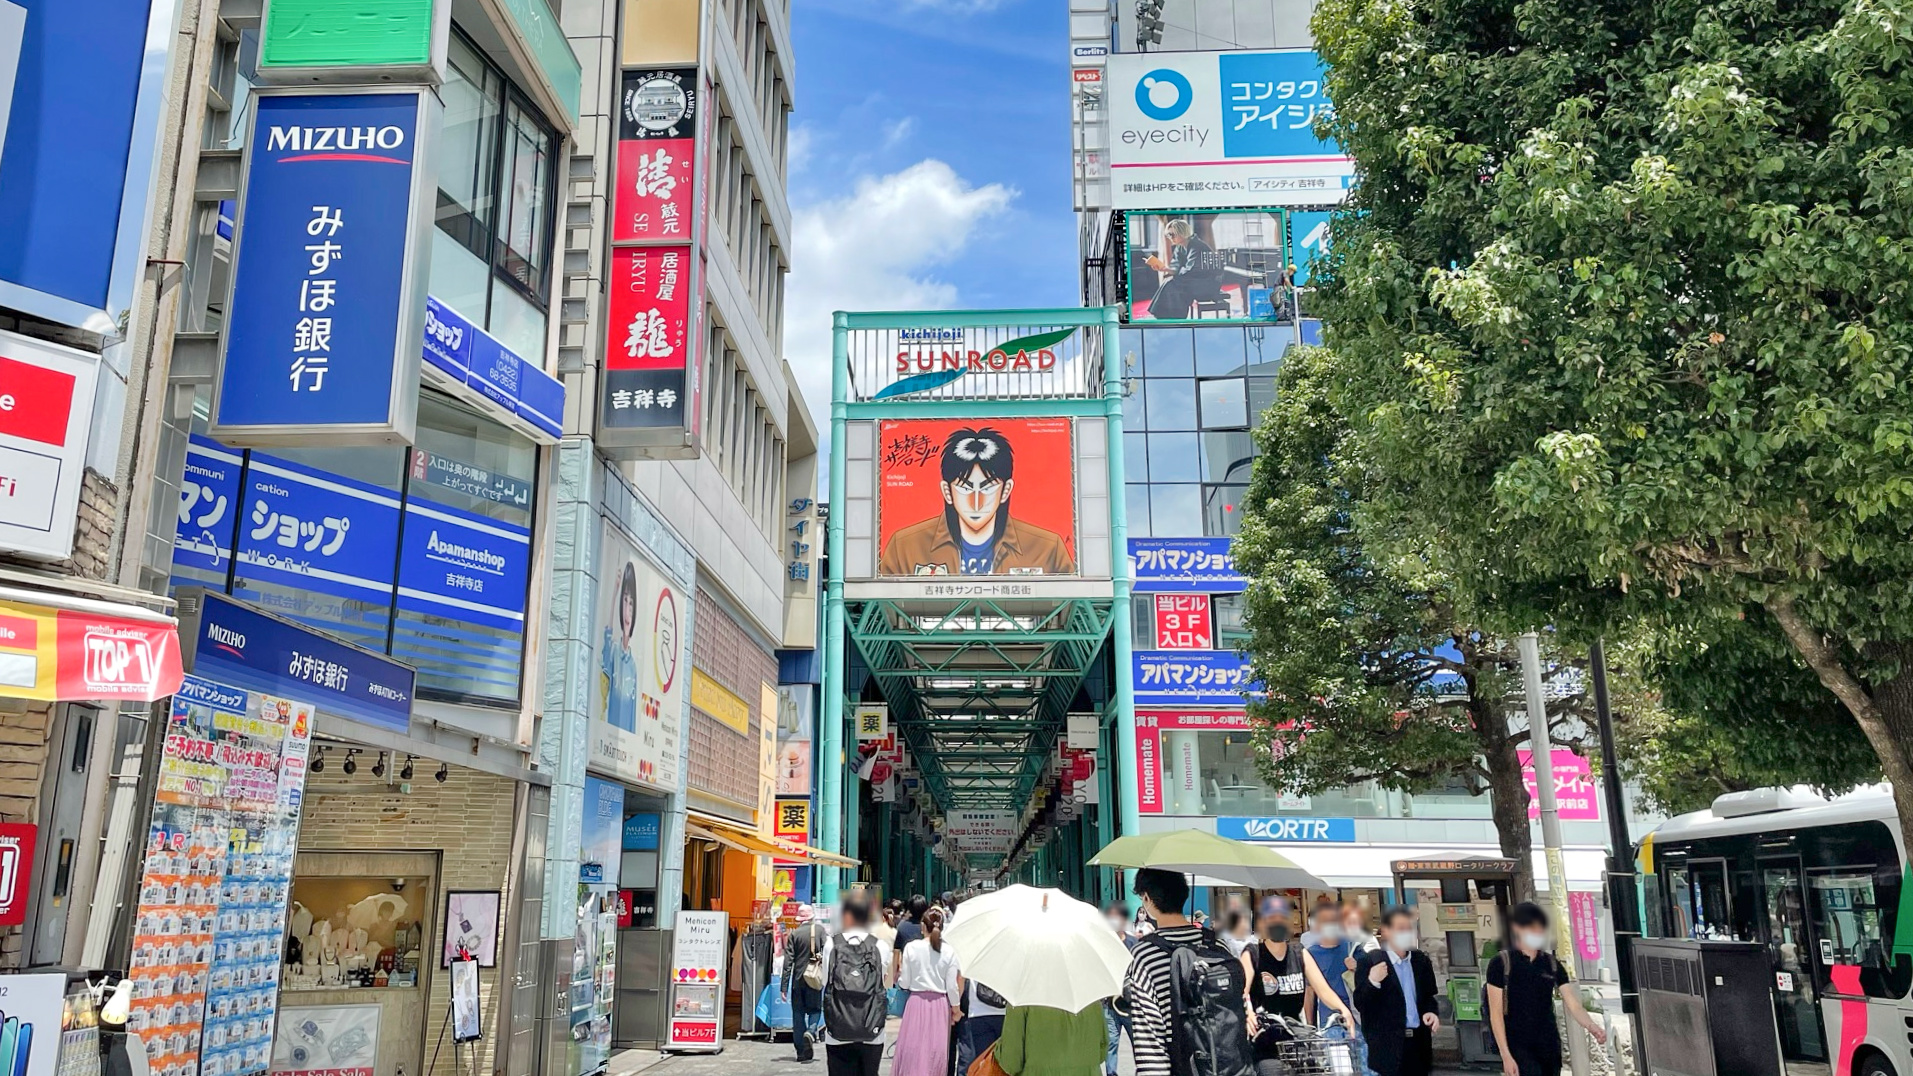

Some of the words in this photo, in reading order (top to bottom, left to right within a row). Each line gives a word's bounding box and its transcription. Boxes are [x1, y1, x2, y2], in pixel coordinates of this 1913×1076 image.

[1231, 81, 1325, 100] コンタク
[684, 90, 695, 120] SEIRYU
[267, 126, 404, 152] MIZUHO
[1121, 125, 1209, 149] eyecity
[681, 161, 690, 183] せい
[1254, 180, 1295, 189] アイシティ
[1299, 179, 1326, 188] 吉祥寺
[1123, 180, 1245, 193] 詳細はHPをご確認ください。
[660, 202, 680, 234] 蔵元
[656, 252, 679, 301] 居酒屋
[290, 205, 343, 392] みずほ銀行
[425, 310, 464, 351] ショップ
[623, 307, 674, 358] 龍
[675, 319, 684, 347] りゅう
[901, 329, 963, 341] kichijoji
[896, 349, 1056, 373] SUNROAD
[611, 388, 677, 410] 吉祥寺
[428, 456, 488, 484] 入口は奥の階段
[255, 482, 289, 498] cation
[442, 475, 504, 501] 上がってすぐです
[251, 499, 350, 557] ショップ
[789, 498, 813, 581] ダイヤ街
[247, 549, 311, 573] WORK
[427, 530, 506, 570] Apamanshop
[1136, 548, 1234, 570] アパマンショッ
[446, 573, 484, 593] 吉祥寺店
[925, 585, 1031, 595] 吉祥寺サンロード商店街
[1158, 596, 1206, 612] 当ビル
[86, 625, 114, 635] mobile
[208, 623, 246, 649] MIZUHO
[1161, 631, 1193, 647] 入口
[88, 638, 130, 682] TOP
[289, 651, 348, 692] みずほ銀行
[87, 685, 118, 693] mobile
[182, 682, 243, 707] アパマンショップ
[863, 715, 880, 732] 薬
[1136, 716, 1158, 727] 賃貸
[1141, 738, 1156, 804] Homemate
[1183, 742, 1193, 790] Homemate
[782, 805, 805, 829] 薬
[949, 828, 1016, 836] 外出はしないでください。
[633, 906, 654, 915] 吉祥寺
[686, 917, 717, 925] Menicon
[691, 926, 711, 934] Miru
[682, 1029, 716, 1038] 当ビル7F
